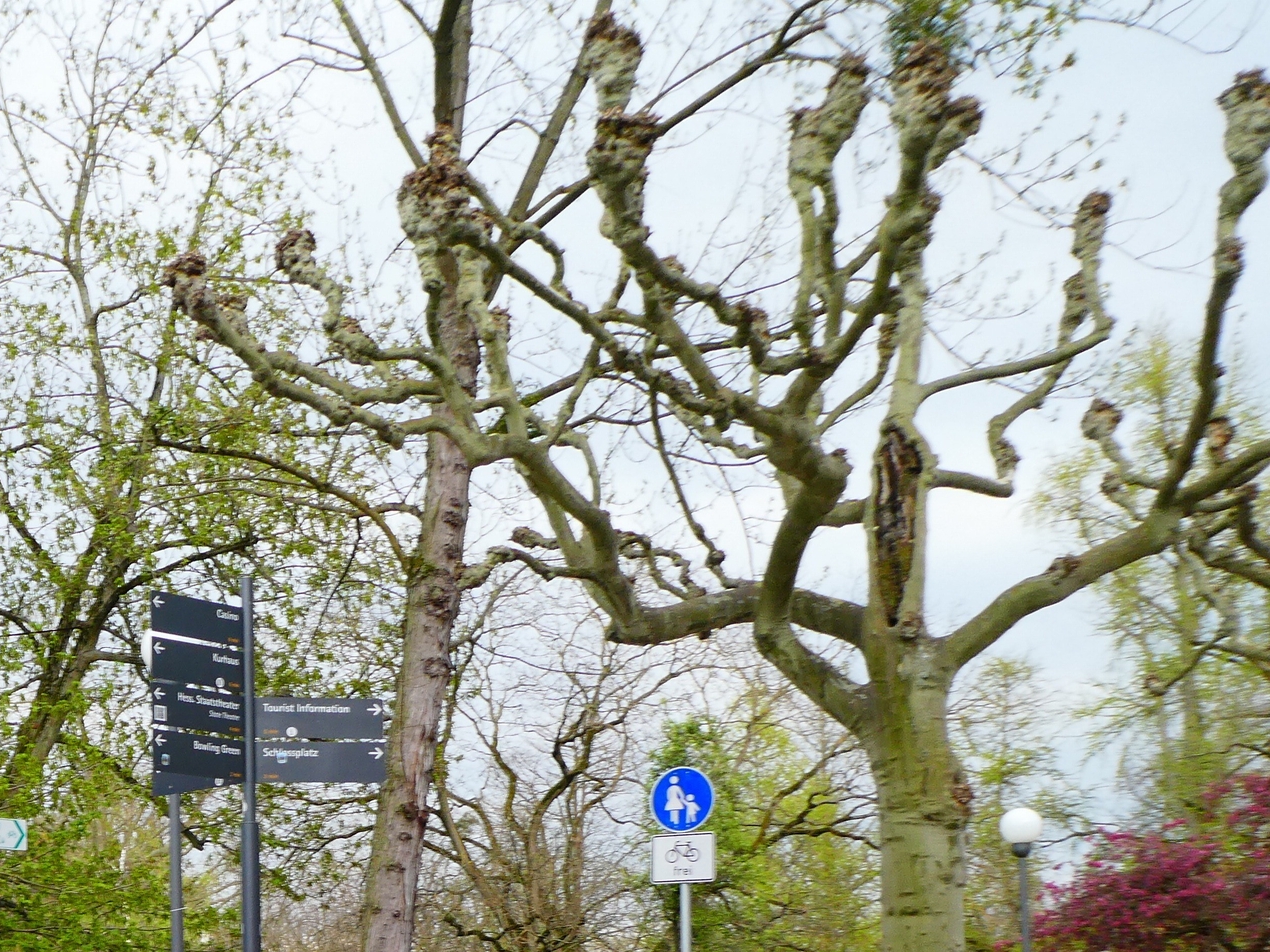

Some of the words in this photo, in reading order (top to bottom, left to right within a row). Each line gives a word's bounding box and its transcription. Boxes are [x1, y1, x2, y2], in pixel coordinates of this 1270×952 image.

[217, 609, 239, 621] Casino
[213, 653, 240, 666] Kurhaus
[195, 695, 241, 710] Staatstheater
[262, 703, 296, 713] Tourist
[296, 704, 351, 713] Information
[193, 741, 221, 755] Bowling
[221, 745, 242, 756] Green
[674, 866, 693, 876] frei
